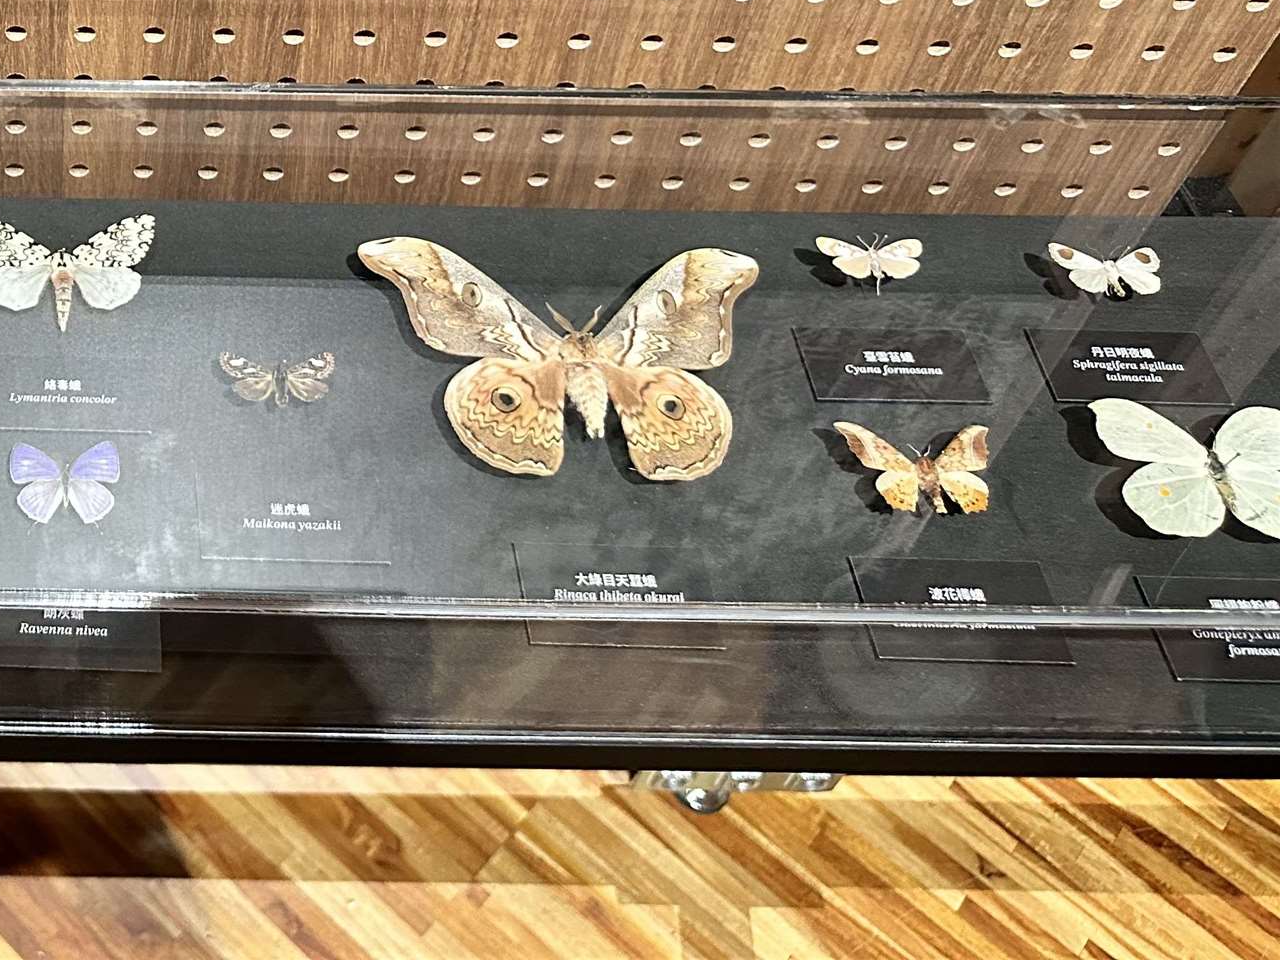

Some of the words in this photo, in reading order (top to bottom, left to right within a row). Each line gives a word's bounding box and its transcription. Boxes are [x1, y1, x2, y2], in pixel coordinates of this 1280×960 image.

[844, 364, 881, 376] Cyana
[882, 364, 943, 376] formosana
[1072, 359, 1138, 372] Sphragifera
[1139, 361, 1185, 373] sigillata
[9, 392, 68, 404] Lymantria
[69, 395, 118, 404] concolor
[243, 518, 296, 529] Maikona
[297, 520, 342, 532] yazakii
[19, 622, 73, 635] Ravenna
[75, 624, 109, 637] nivea
[1228, 643, 1280, 658] formosa
